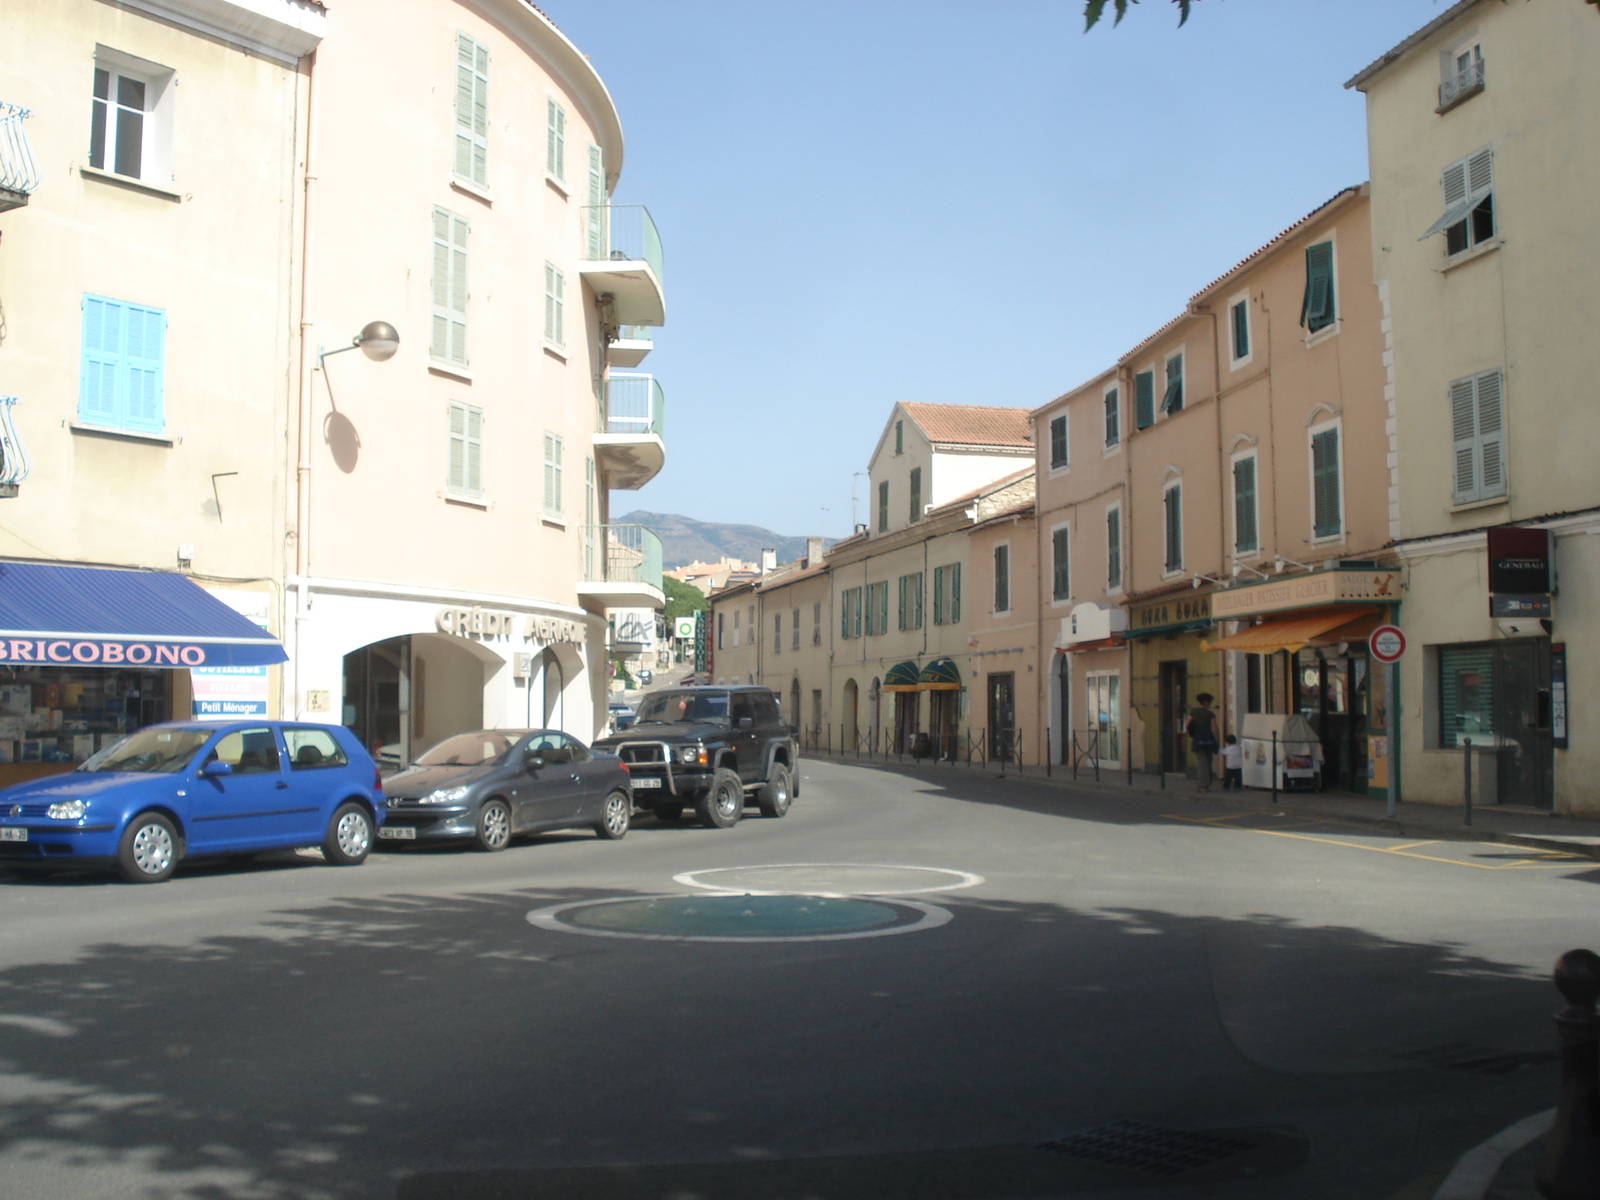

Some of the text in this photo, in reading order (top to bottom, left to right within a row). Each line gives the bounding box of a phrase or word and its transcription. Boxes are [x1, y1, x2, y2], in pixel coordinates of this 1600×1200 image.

[1296, 579, 1328, 599] GLACIER
[1176, 599, 1208, 620] BORA
[523, 615, 588, 643] AGRICOLE
[210, 683, 251, 693] VISSERIE
[201, 701, 258, 715] Petit Ménager
